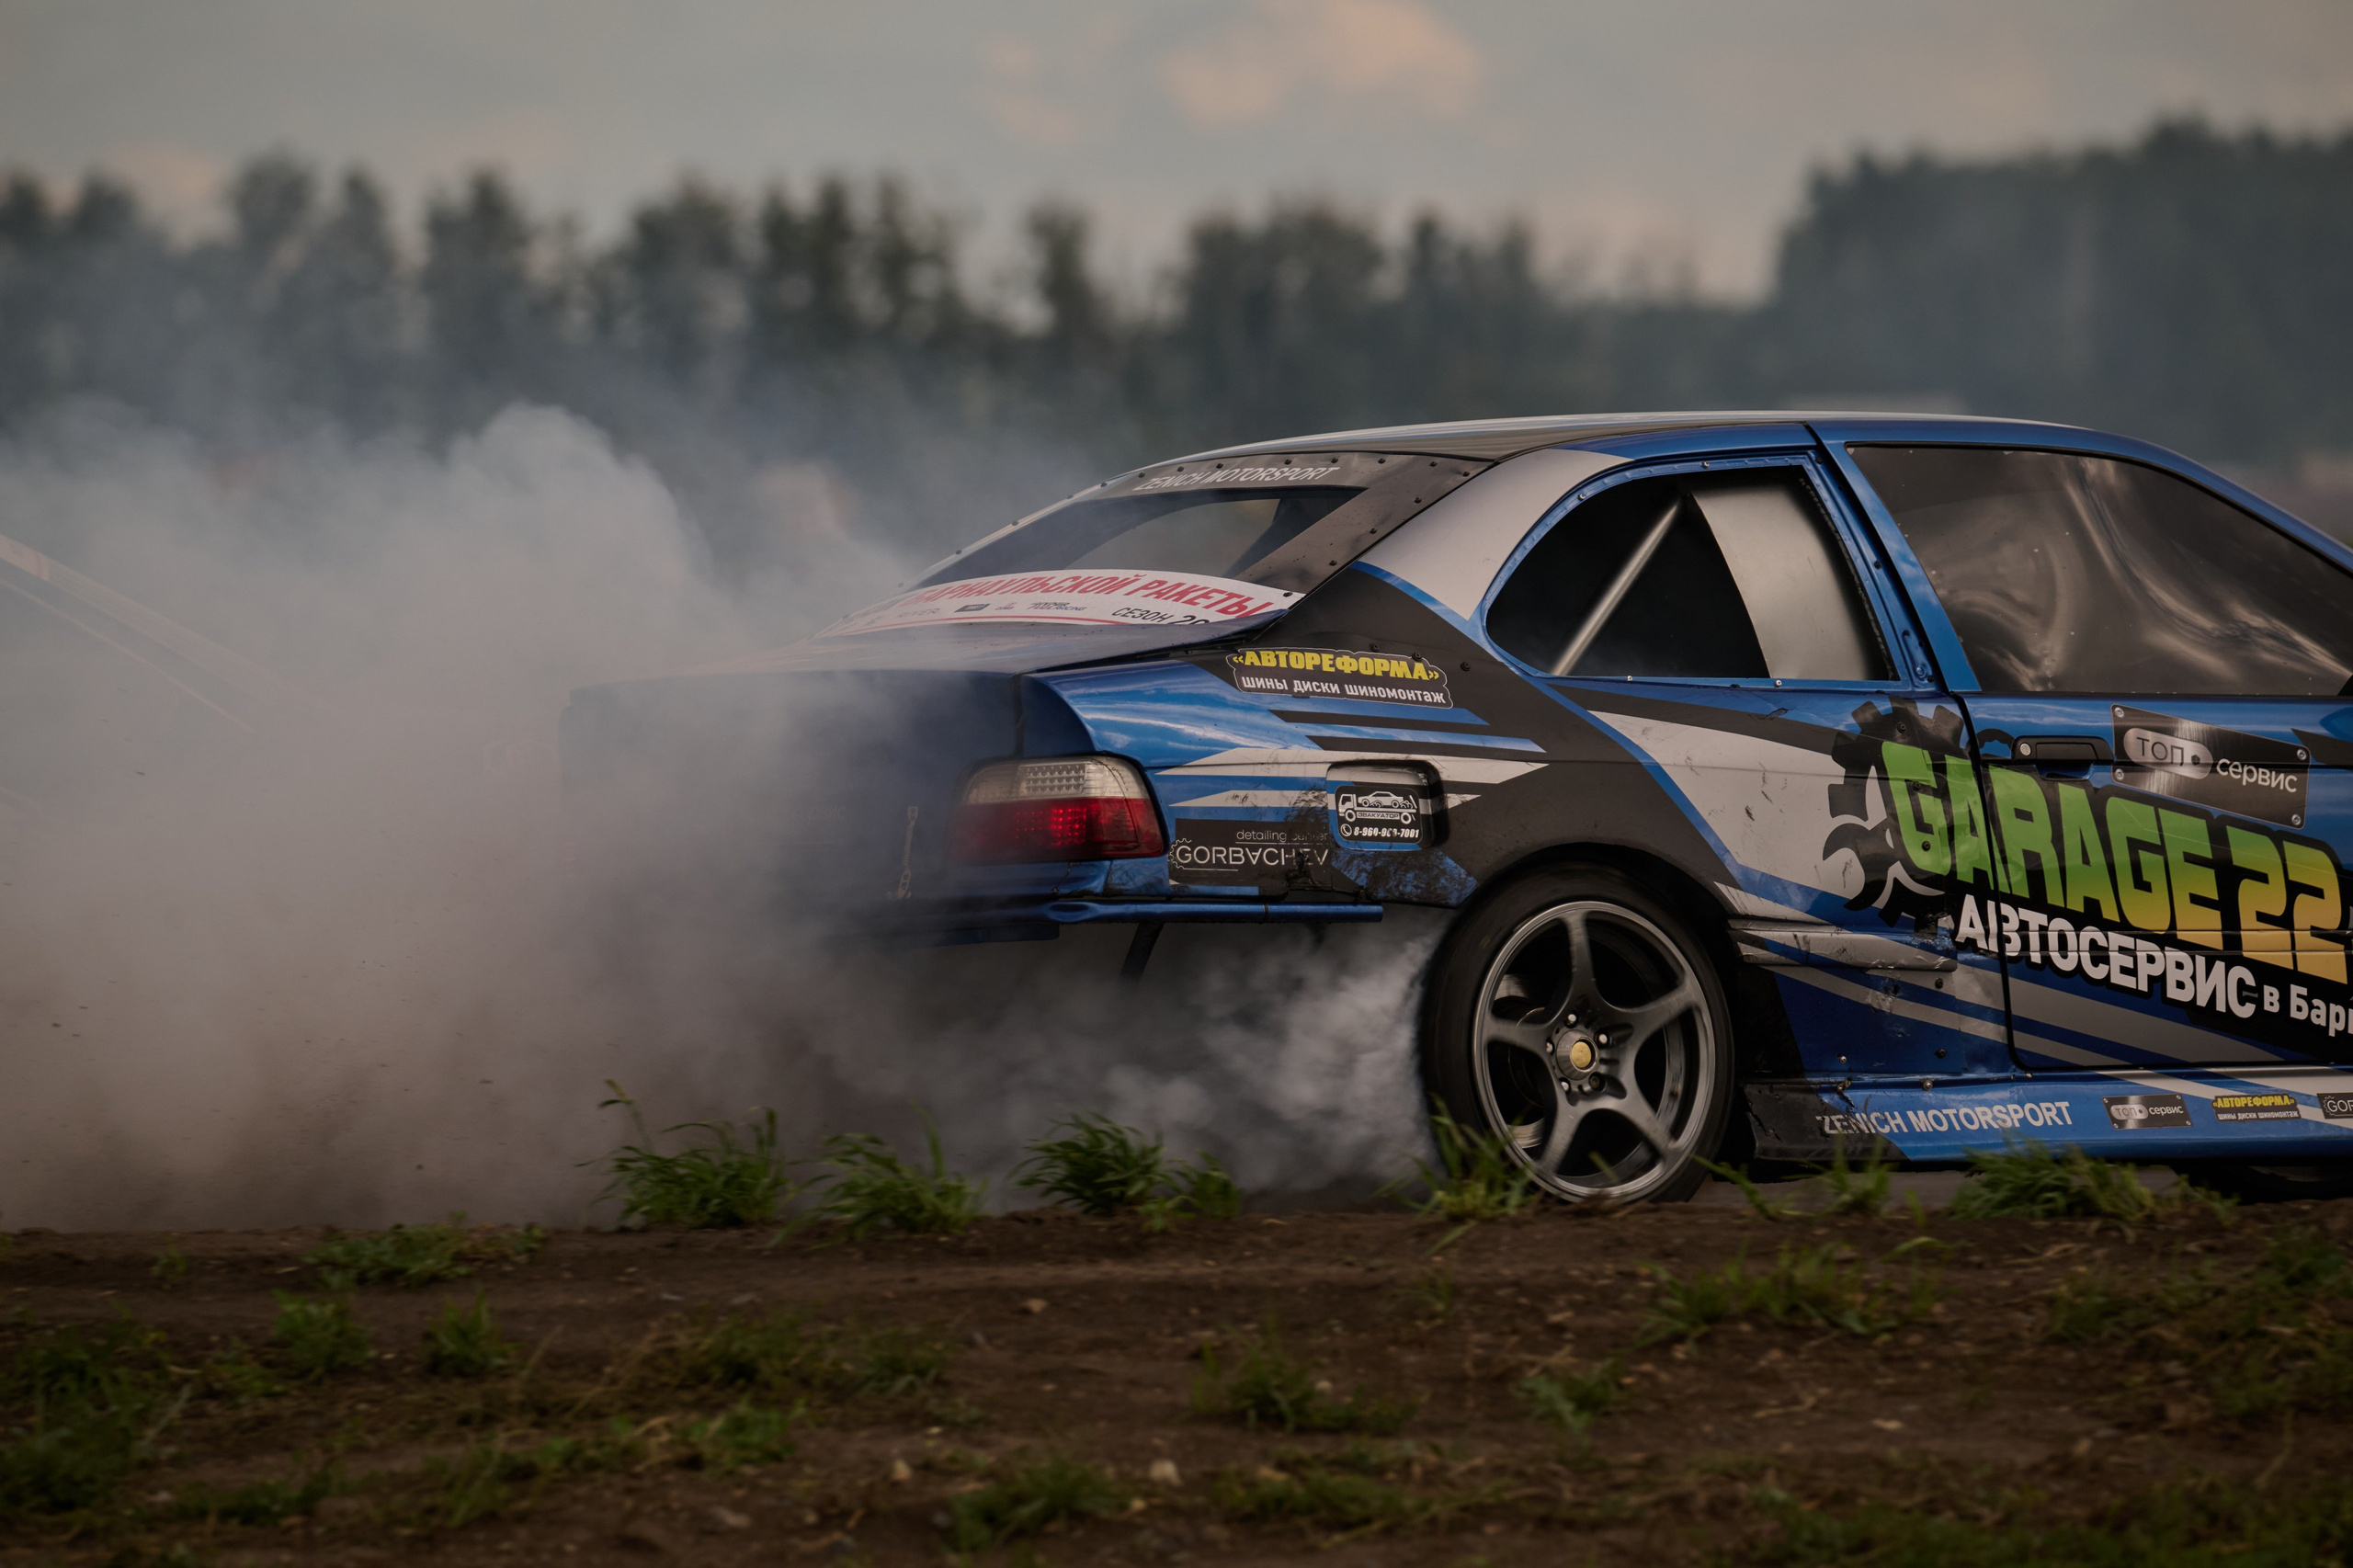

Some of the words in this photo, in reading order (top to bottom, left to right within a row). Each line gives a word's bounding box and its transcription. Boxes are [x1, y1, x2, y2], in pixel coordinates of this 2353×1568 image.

[1132, 471, 1208, 491] ZENICH
[1202, 466, 1341, 483] MOTORSPORT
[1123, 578, 1275, 618] РАКЕТЫ
[1111, 607, 1176, 623] СЕЗОН
[1233, 651, 1439, 681] «АВТОРЕФОРМА»
[2135, 735, 2185, 767] ТОП
[2216, 757, 2299, 794] сервис
[1236, 830, 1287, 843] detailing
[1882, 741, 2223, 951] GARAGE
[2226, 824, 2348, 984] 22
[1955, 893, 2258, 1019] АВТОСЕРВИС
[1815, 1111, 1908, 1134] ZENICH
[1906, 1101, 2074, 1132] MOTORSPORT
[2115, 1107, 2139, 1118] ТОП
[2148, 1106, 2184, 1117] сервис
